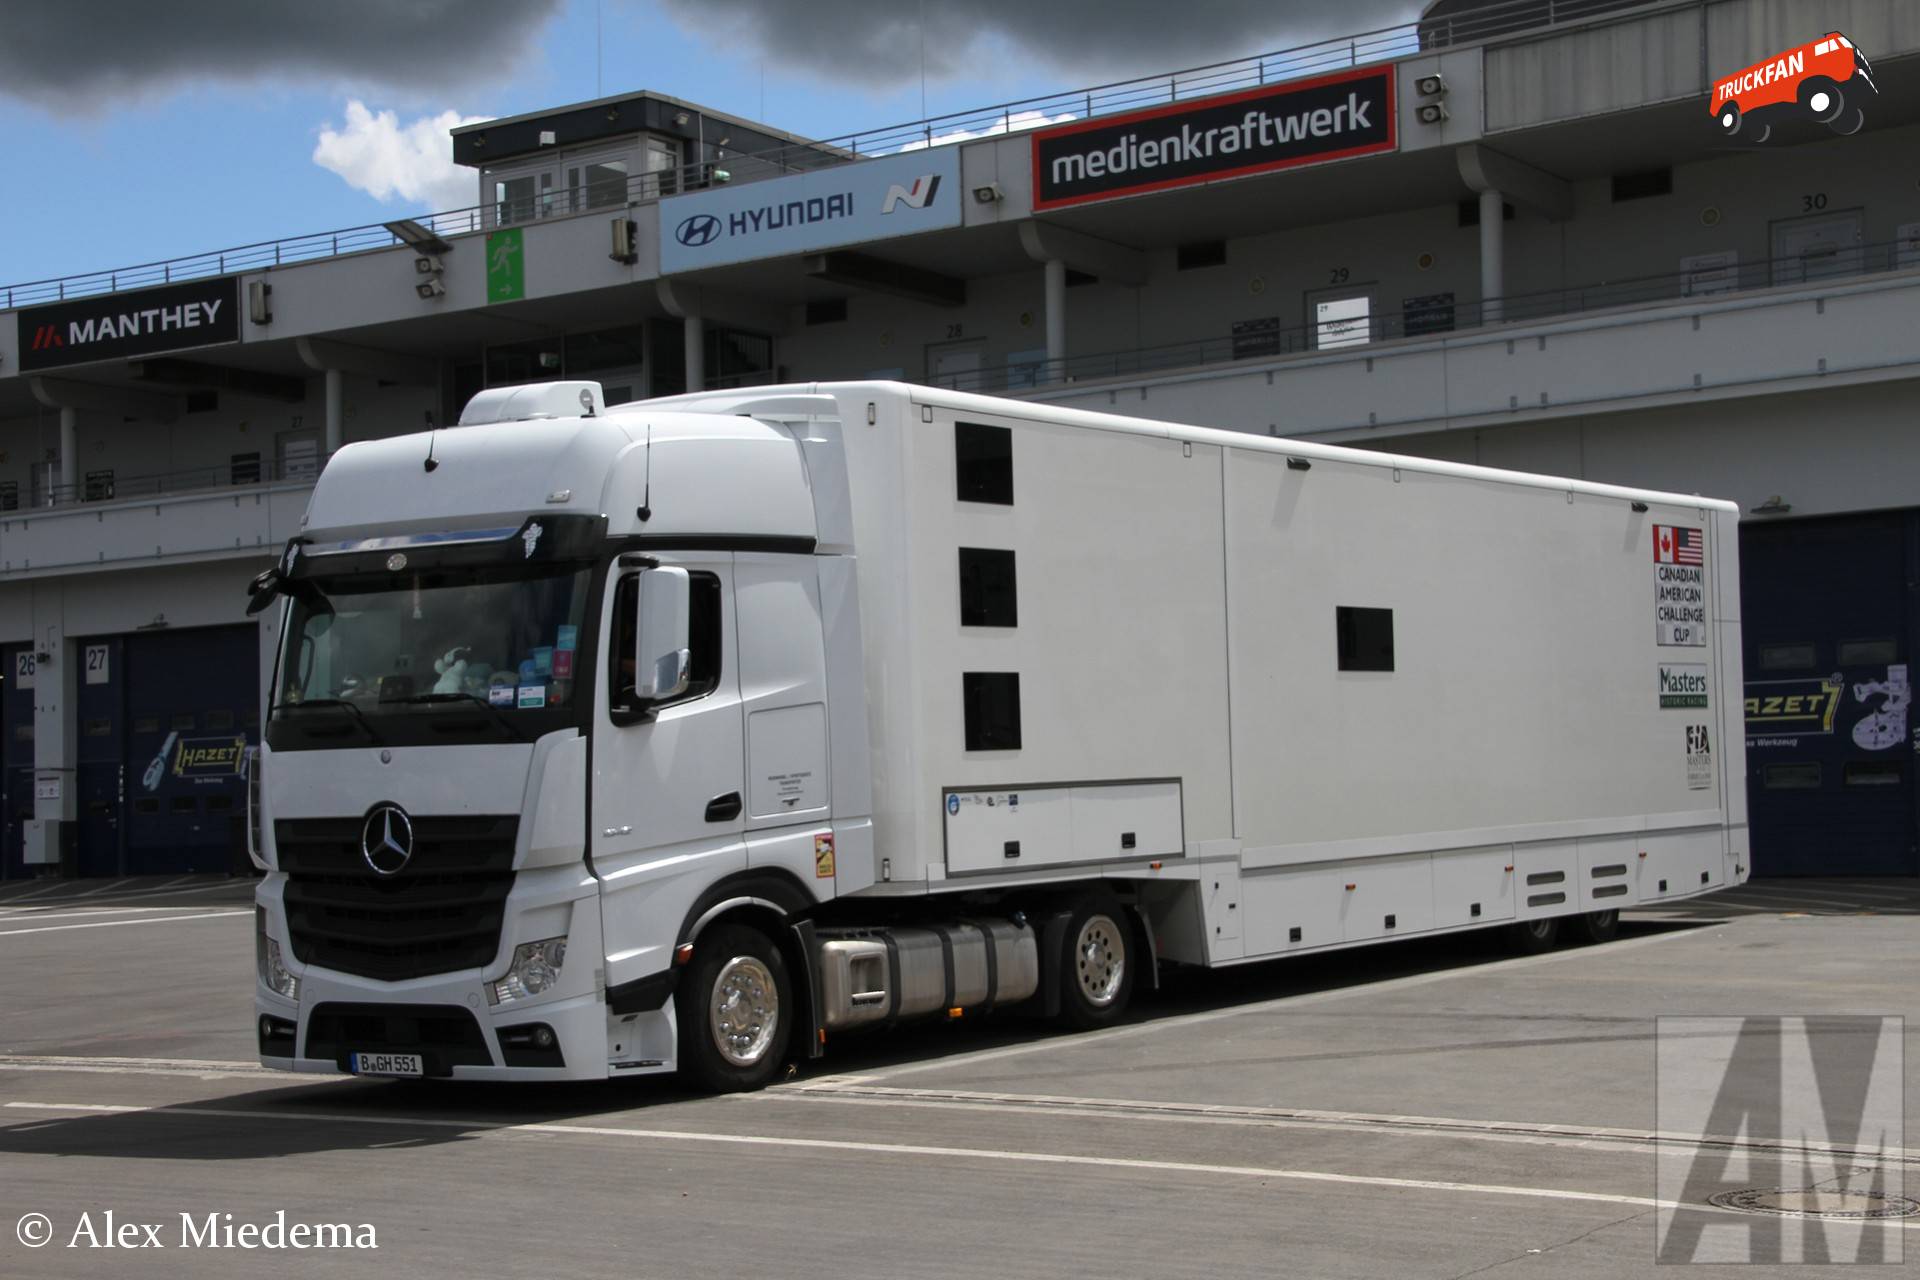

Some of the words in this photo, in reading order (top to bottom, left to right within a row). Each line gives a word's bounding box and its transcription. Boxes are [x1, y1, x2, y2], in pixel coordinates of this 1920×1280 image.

[1053, 93, 1371, 184] medienkraftwerk
[1802, 193, 1828, 212] 30
[730, 193, 853, 236] HYUNDAI
[1330, 268, 1349, 284] 29
[69, 299, 222, 345] MANTHEY
[947, 324, 963, 339] 28
[291, 415, 304, 429] 27
[1659, 567, 1700, 582] CANADIAN
[1660, 586, 1701, 602] AMERICAN
[1658, 606, 1703, 622] CHALLENGE
[1674, 627, 1690, 641] CUP
[19, 655, 35, 676] 26
[88, 648, 106, 671] 27
[1660, 667, 1706, 693] Masters
[1744, 694, 1824, 716] AZET
[182, 747, 237, 767] HAZET
[361, 1055, 370, 1071] B
[376, 1056, 392, 1072] GH
[394, 1056, 418, 1073] 551
